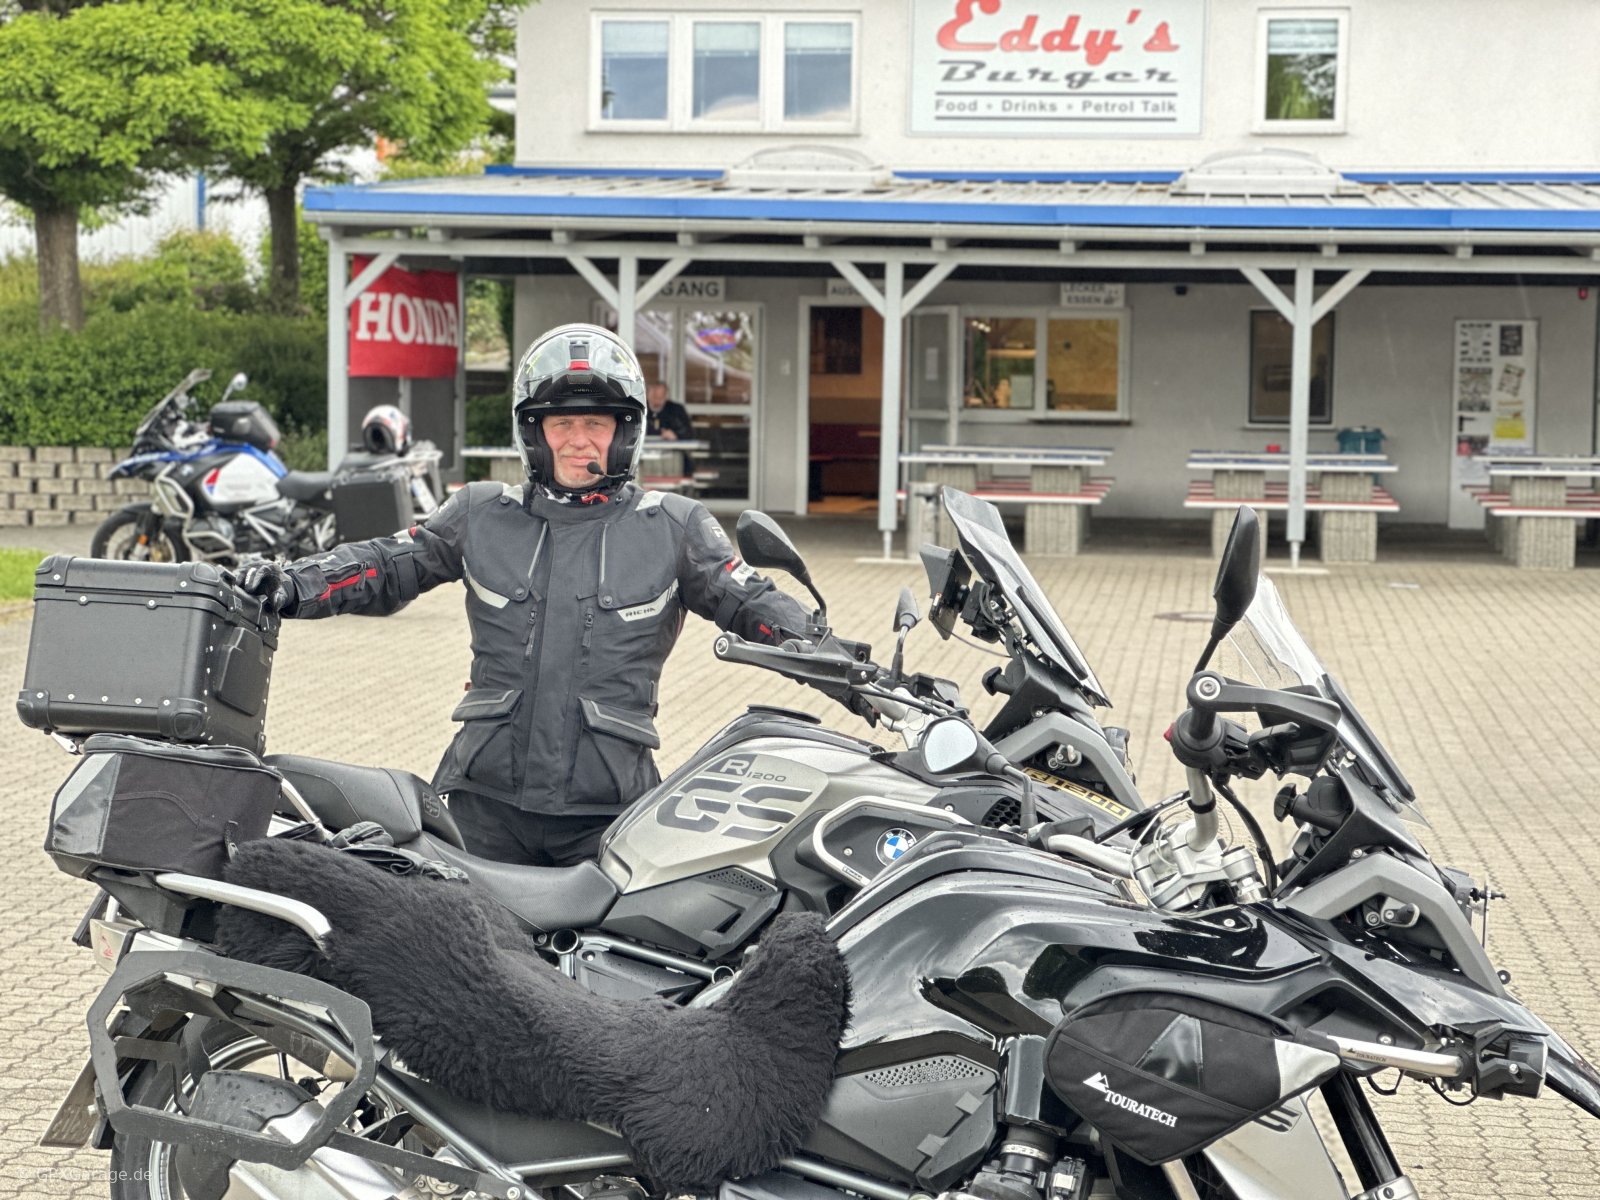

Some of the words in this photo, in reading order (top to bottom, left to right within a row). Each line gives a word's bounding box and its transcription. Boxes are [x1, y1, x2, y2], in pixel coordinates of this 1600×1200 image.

[936, 0, 1180, 66] Eddy's
[938, 60, 1178, 89] Burger
[934, 99, 978, 112] Food
[1001, 100, 1058, 112] Drinks
[1082, 101, 1134, 113] Petrol
[1141, 101, 1177, 113] Talk
[642, 281, 719, 297] GANG
[356, 292, 457, 347] HONDA
[655, 776, 813, 842] GS
[886, 829, 916, 848] BMW
[1356, 1052, 1386, 1062] TOURATECH
[1104, 1089, 1178, 1128] TOURATECH
